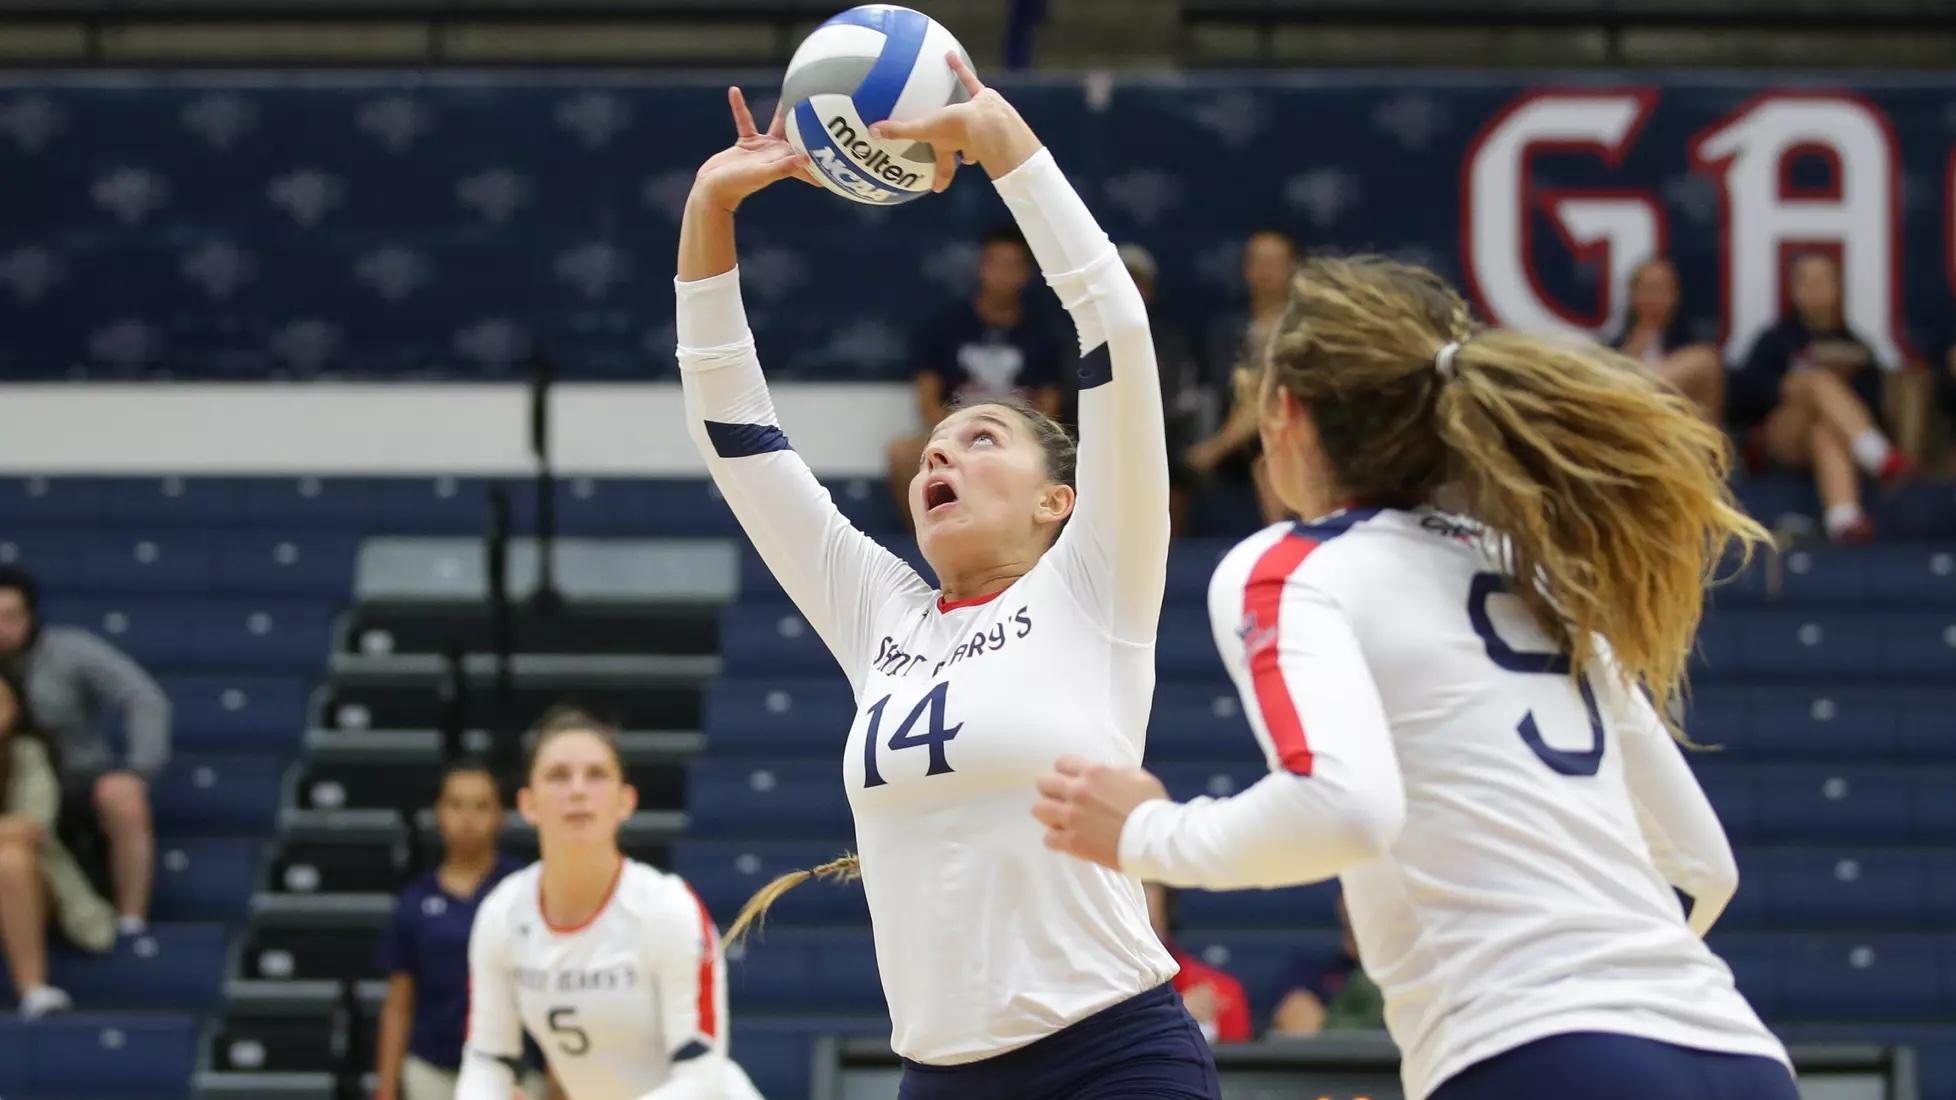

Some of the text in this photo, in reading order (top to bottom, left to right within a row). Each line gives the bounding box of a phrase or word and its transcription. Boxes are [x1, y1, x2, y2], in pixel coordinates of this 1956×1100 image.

[809, 146, 893, 200] NCAA
[827, 115, 920, 188] molten
[1461, 87, 1956, 374] GA
[873, 636, 927, 676] SNT
[864, 681, 964, 788] 14
[548, 1008, 590, 1056] 5
